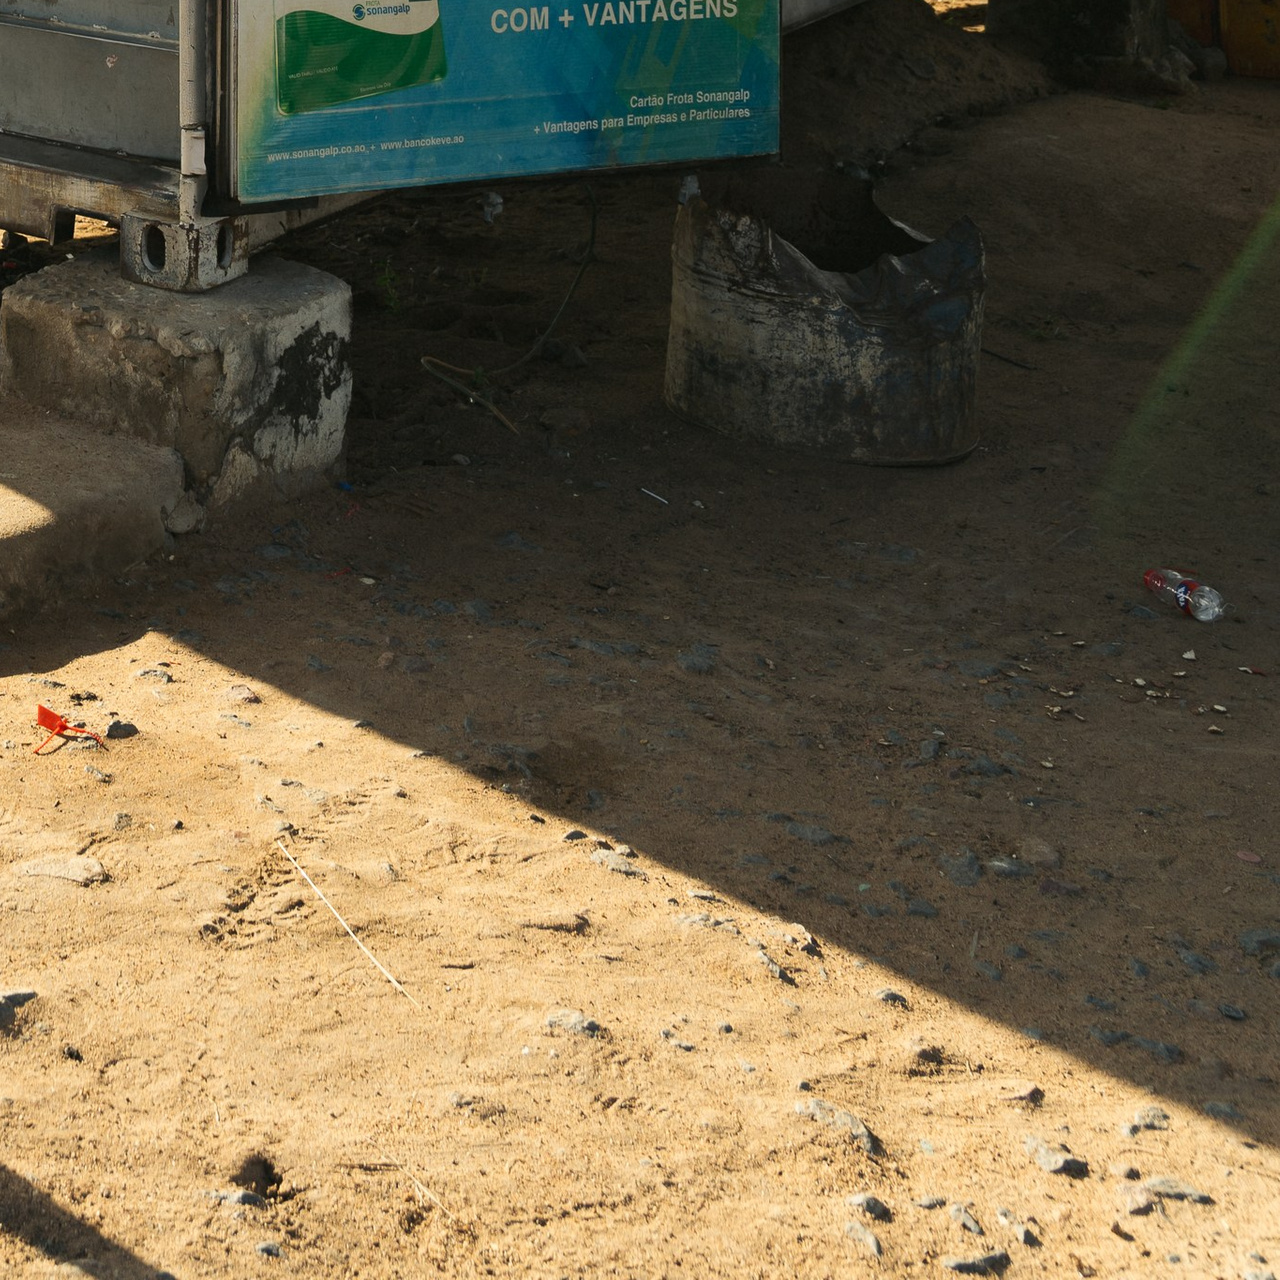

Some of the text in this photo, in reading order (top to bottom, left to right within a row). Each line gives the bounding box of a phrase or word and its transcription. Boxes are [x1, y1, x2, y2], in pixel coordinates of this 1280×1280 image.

[367, 3, 411, 15] sonangalp
[491, 6, 549, 33] COM
[558, 9, 574, 28] +
[630, 89, 750, 108] Cartão Frota Sonangalp
[543, 118, 599, 134] Vantagens
[601, 116, 625, 131] para
[627, 112, 678, 127] Empresas
[680, 112, 687, 122] e
[689, 107, 751, 122] Particulares
[268, 143, 366, 162] www.sonangalp.co.ao
[380, 135, 465, 151] www.bancokeve.ao
